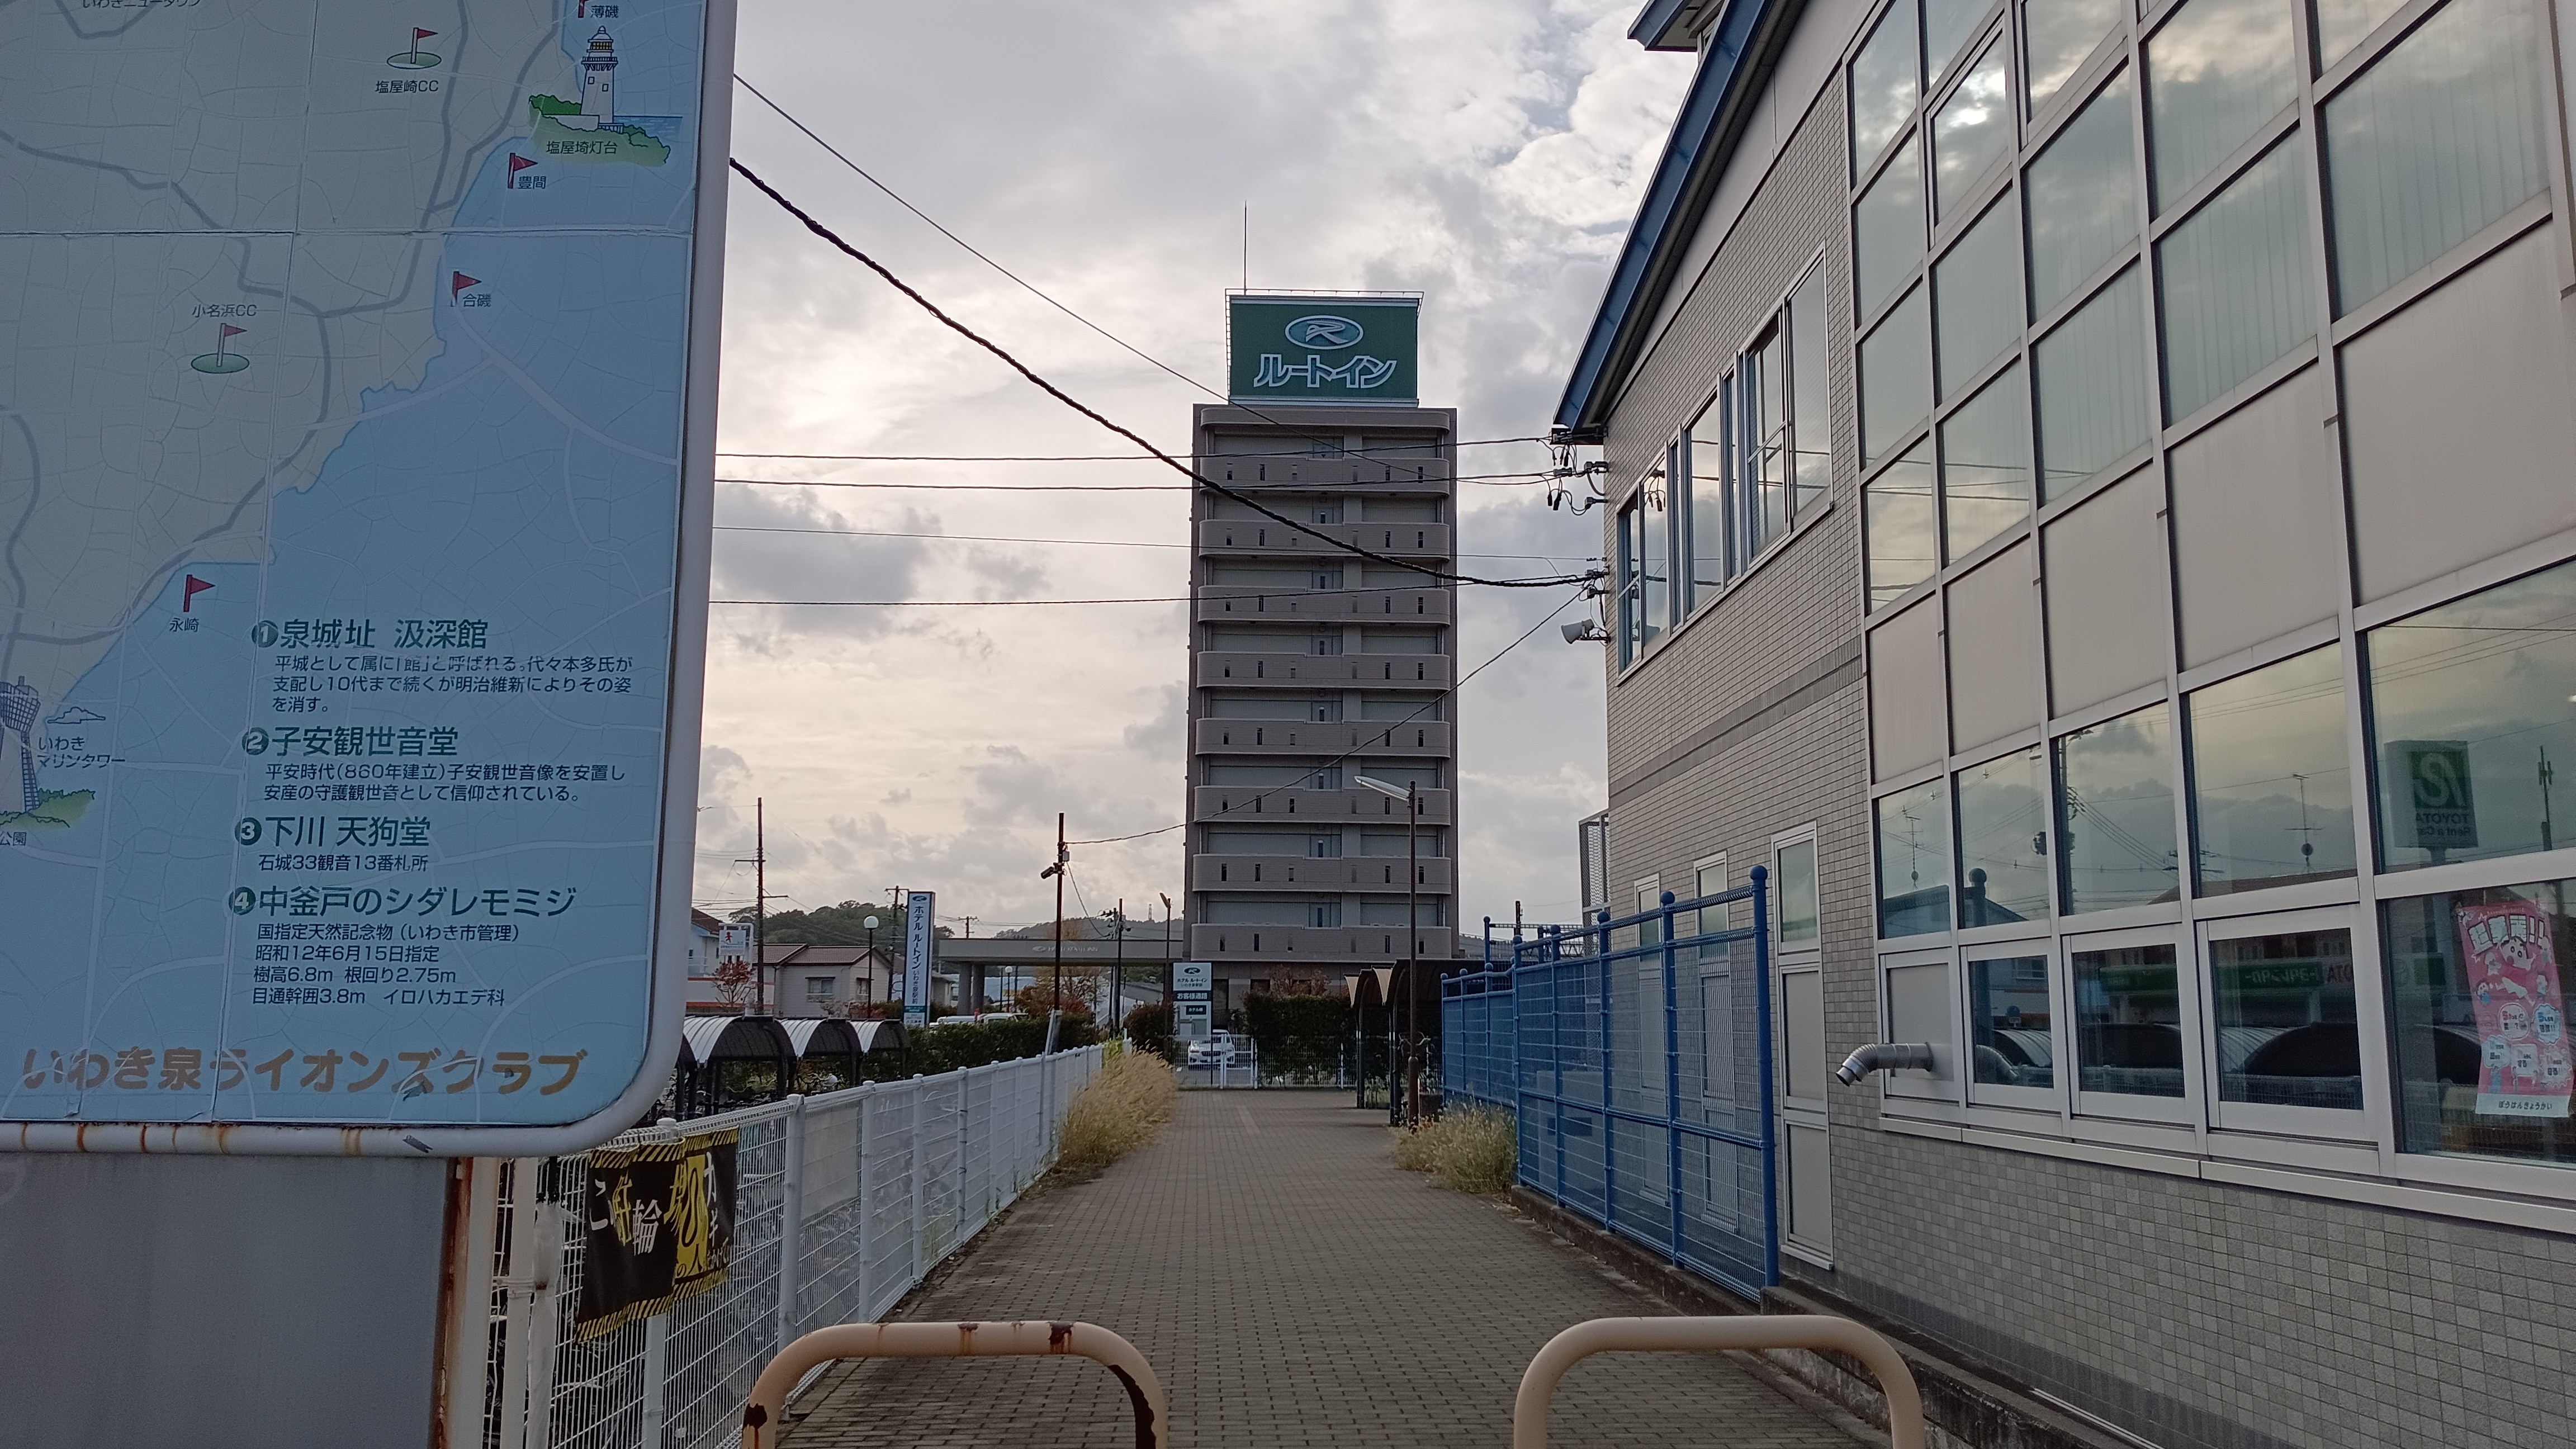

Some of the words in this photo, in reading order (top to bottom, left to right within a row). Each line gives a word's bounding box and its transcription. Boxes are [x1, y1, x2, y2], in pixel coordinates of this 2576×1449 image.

[590, 5, 619, 18] 薄磯
[375, 80, 439, 93] 塩屋崎CC
[546, 141, 618, 154] 塩屋埼灯台
[518, 176, 547, 190] 豊間
[463, 294, 491, 307] 合磯
[192, 304, 257, 318] 小名浜CC
[1253, 353, 1398, 389] ルートイン
[169, 617, 200, 632] 永崎
[280, 618, 375, 648] 泉城址
[394, 619, 488, 649] 汲深館
[273, 675, 632, 693] 支配し10代まで続くが明治維新によりその姿
[272, 697, 329, 713] を消す。
[38, 736, 85, 751] いわき
[271, 726, 458, 757] 子安観世音堂
[37, 755, 126, 768] マリンタワー
[266, 763, 625, 782] 平安時代（860年建立）子安観世音像を安置し
[264, 784, 579, 803] 安産の守護観世音として信仰されている。
[265, 816, 325, 848] 下川
[337, 816, 430, 848] 天狗堂
[258, 854, 428, 872] 石城33観音13番札所
[259, 885, 577, 918] 中釜戸のシダレモミジ
[913, 906, 924, 931] ホテル
[255, 945, 439, 963] 昭和12年6月15日指定
[911, 934, 923, 969] ルートイン
[253, 965, 333, 983] 樹高6.8m
[344, 967, 456, 984] 根回り2.75m
[252, 987, 365, 1005] 目通幹囲3.8m
[383, 988, 505, 1006] イロハカエデ科
[23, 1046, 588, 1096] いわき泉ライオンズクラブ
